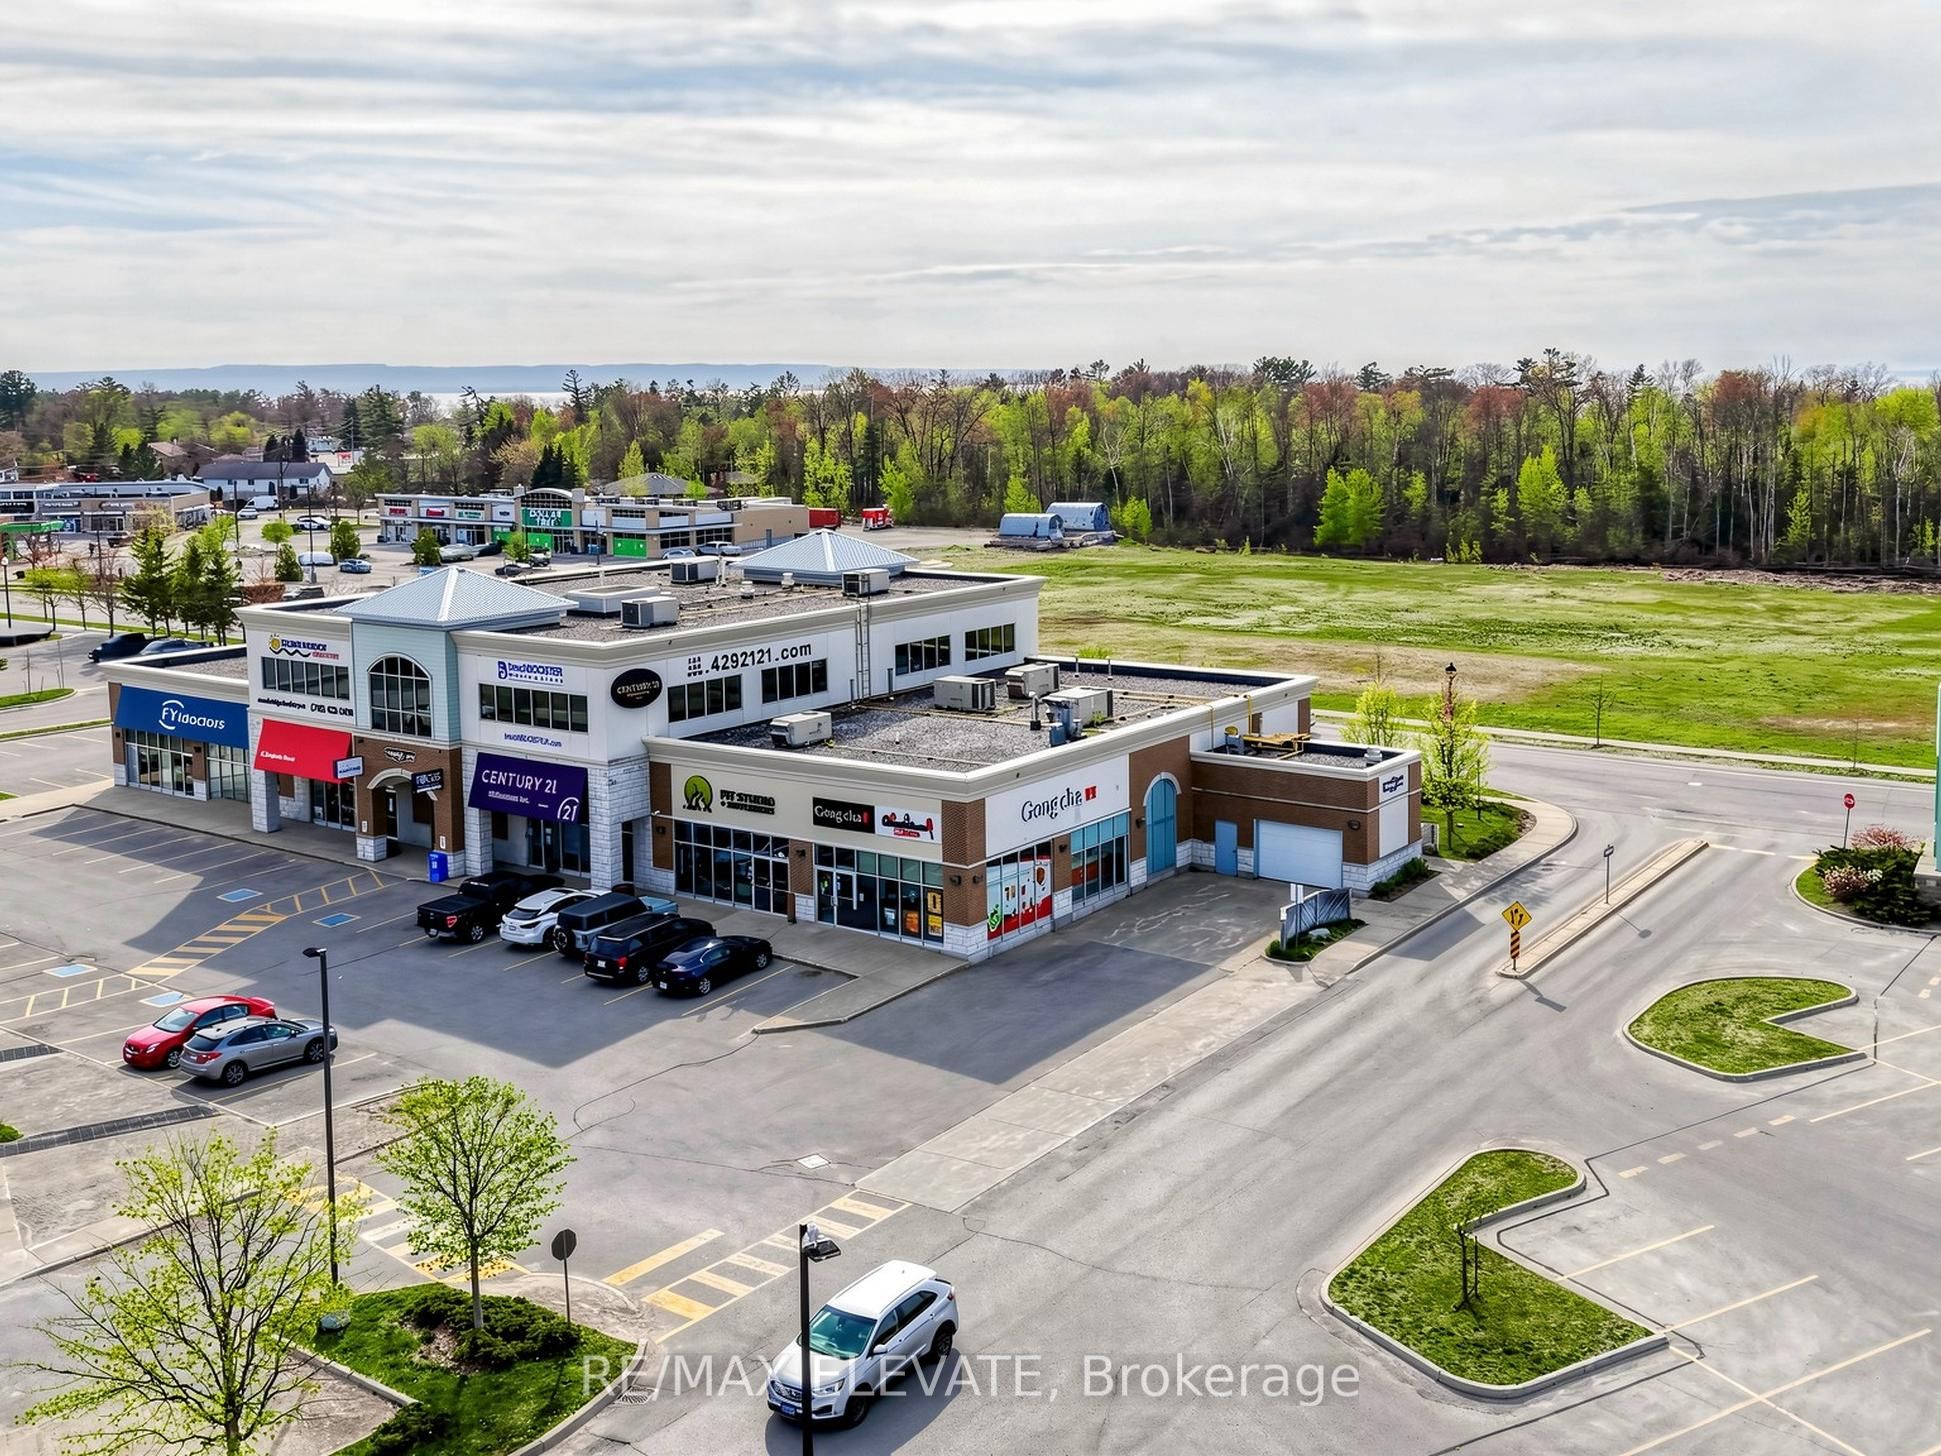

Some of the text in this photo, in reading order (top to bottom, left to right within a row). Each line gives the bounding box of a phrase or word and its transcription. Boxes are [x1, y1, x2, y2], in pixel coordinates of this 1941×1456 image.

[481, 769, 558, 794] CENTURY 21
[562, 805, 578, 822] 21
